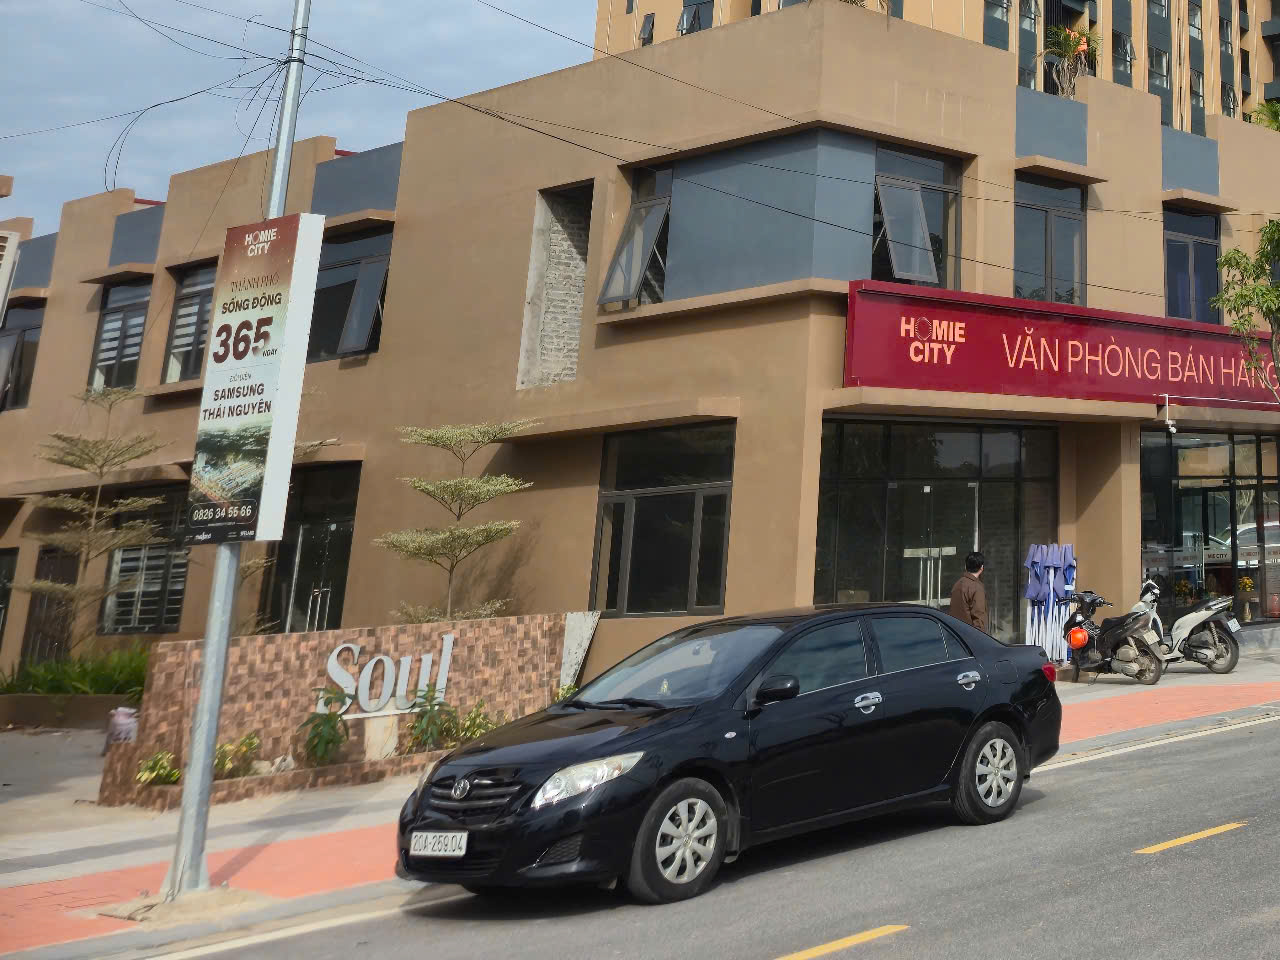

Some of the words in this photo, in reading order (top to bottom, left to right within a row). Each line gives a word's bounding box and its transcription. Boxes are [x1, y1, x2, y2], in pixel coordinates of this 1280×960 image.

[247, 242, 271, 257] CITY
[221, 296, 251, 314] SỐNG
[252, 292, 282, 311] ĐỘNG
[212, 315, 274, 364] 365
[900, 316, 966, 343] HOMIE
[909, 341, 956, 365] CITY
[1002, 326, 1060, 372] VĂN
[1067, 336, 1161, 381] PHÒNG
[1168, 345, 1215, 385] BÁN
[213, 383, 265, 402] SAMSUNG
[202, 403, 226, 421] THÁI
[227, 398, 272, 418] NGUYÊN
[193, 507, 214, 521] 0826
[215, 507, 226, 519] 34
[228, 506, 239, 518] 55
[240, 505, 252, 517] 66
[316, 632, 456, 717] Soul
